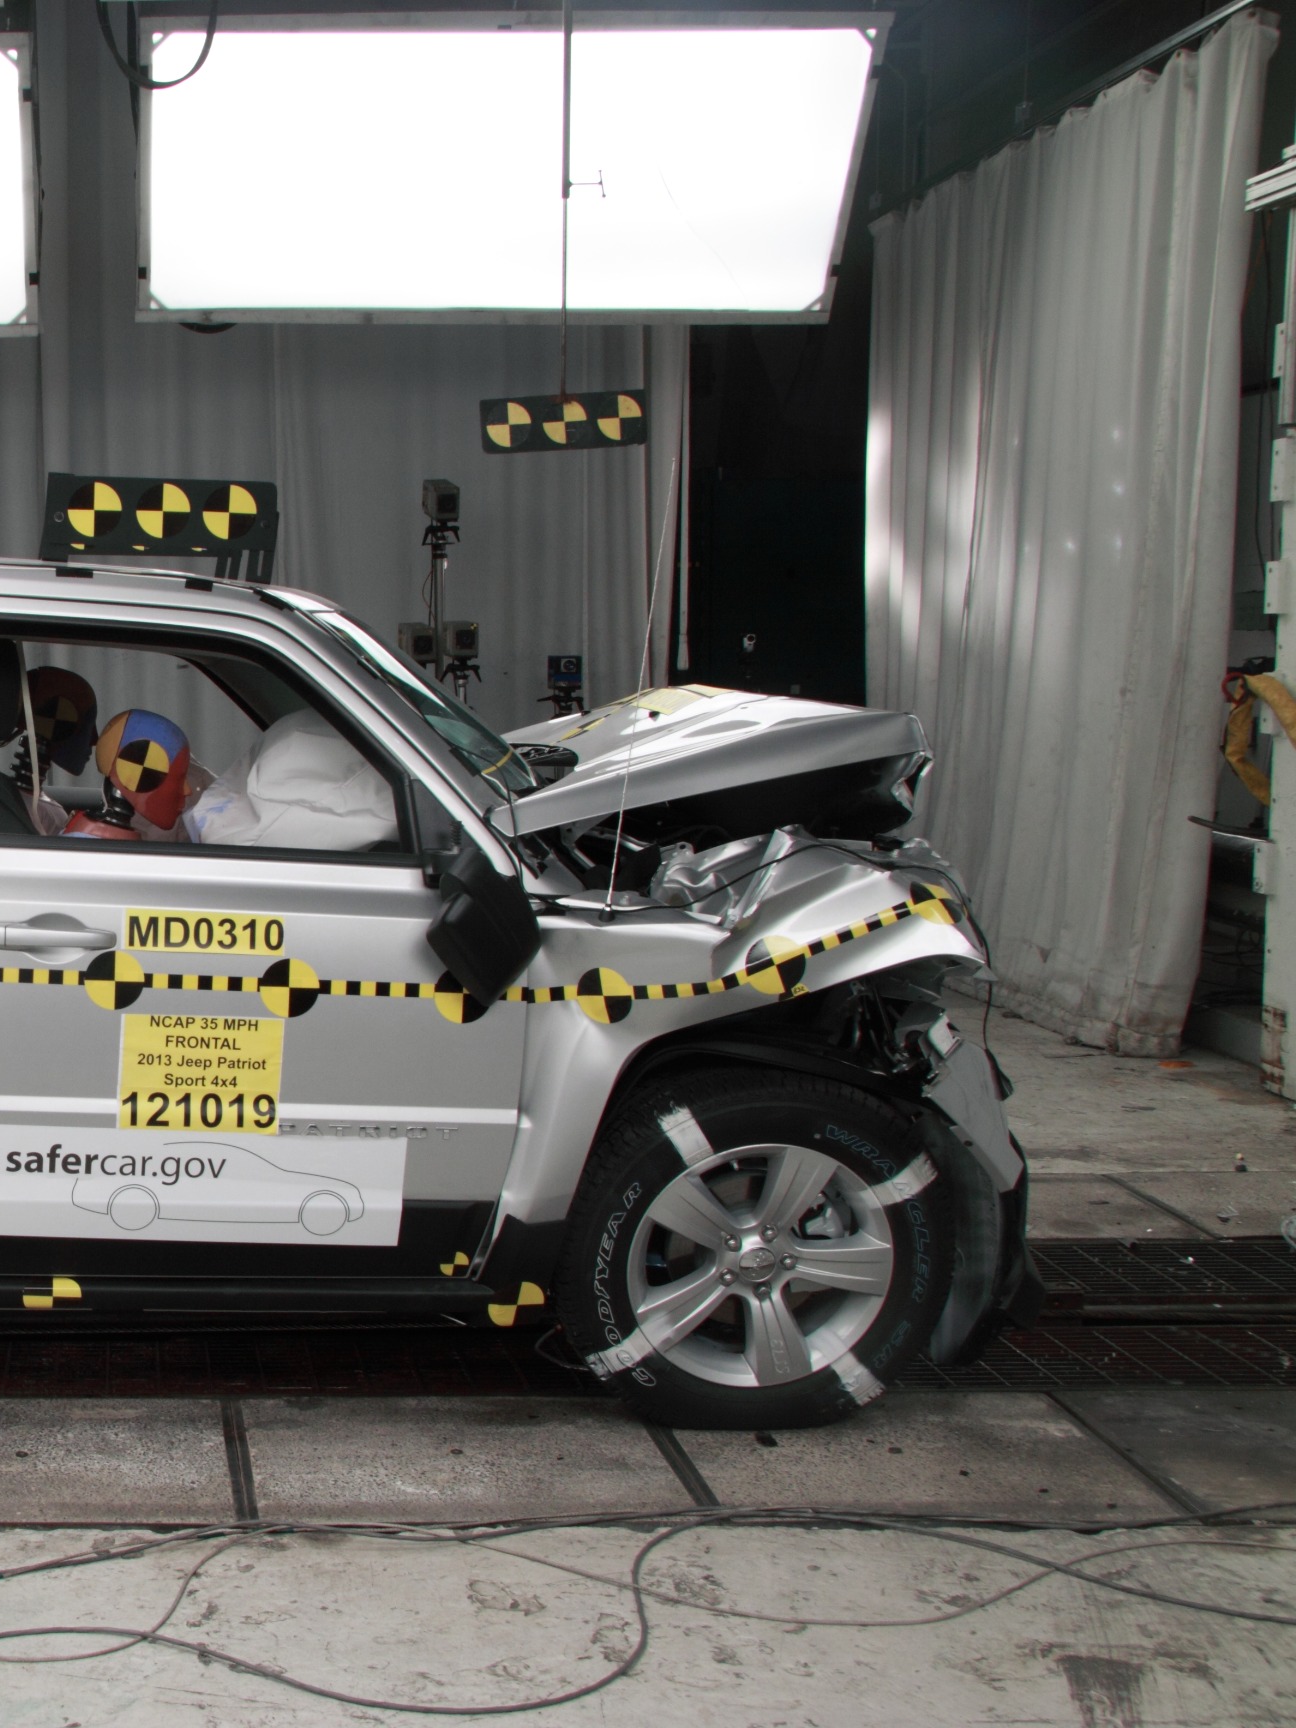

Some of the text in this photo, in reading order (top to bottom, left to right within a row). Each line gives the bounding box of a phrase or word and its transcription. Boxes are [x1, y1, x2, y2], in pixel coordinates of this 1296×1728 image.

[127, 915, 285, 951] MD0310
[149, 1015, 259, 1032] NCAP 35 MPH
[165, 1035, 242, 1051] FRONTAL
[137, 1054, 267, 1071] 2013 Jeep Patriot
[163, 1073, 238, 1088] Sport 4x4
[121, 1091, 277, 1129] 121019
[279, 1123, 459, 1140] PATRIOT
[5, 1143, 227, 1186] safercar.gov
[593, 1182, 657, 1387] GOODYEAR
